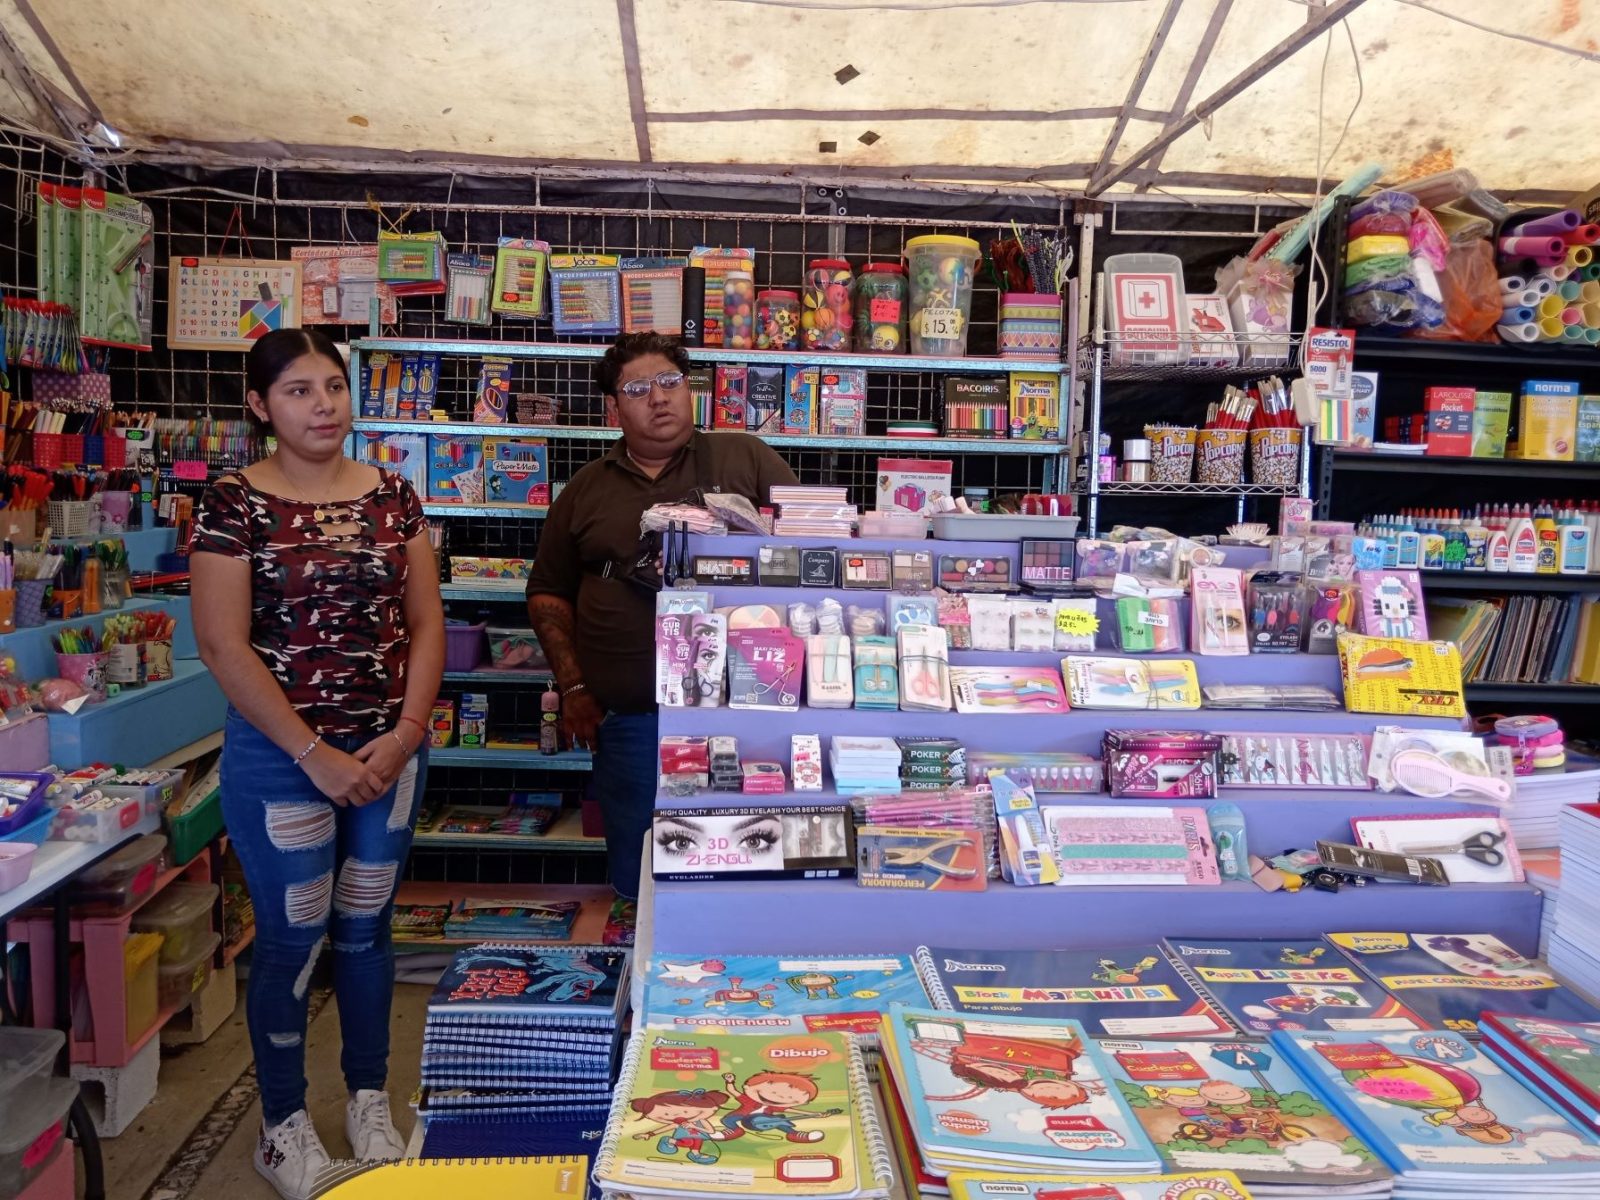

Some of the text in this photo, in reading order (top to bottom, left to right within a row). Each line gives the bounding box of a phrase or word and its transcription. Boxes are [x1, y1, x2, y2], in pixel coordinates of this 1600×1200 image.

[1312, 337, 1349, 348] RESISTOL
[956, 384, 999, 393] BACOIRIS
[1019, 382, 1051, 396] Norma
[1535, 383, 1572, 393] norma
[1433, 391, 1472, 400] LAROUSSE
[1440, 403, 1464, 412] Pocket
[485, 445, 495, 453] 48
[1204, 439, 1244, 462] POPCORN
[495, 461, 538, 472] Paper Mate
[1024, 566, 1071, 580] MATTE
[753, 650, 786, 663] LIZ
[910, 751, 941, 759] POKER
[911, 765, 942, 773] POKER
[909, 782, 940, 790] POKER
[678, 808, 707, 816] QUALITY
[740, 807, 749, 815] 3D
[749, 807, 781, 815] EYELASH
[781, 806, 801, 814] YOUR
[820, 805, 847, 813] CHOICE
[707, 837, 730, 850] 3D
[862, 878, 926, 888] PERFORADORA
[1182, 946, 1231, 956] Norma
[948, 959, 1005, 972] Norma
[1205, 969, 1351, 981] Papel Lustre
[1396, 976, 1544, 989] PAPEL CONSTRUCCIÓN
[964, 988, 1164, 1001] Block Marquilla
[964, 1003, 1023, 1012] Para dibujo
[1443, 1019, 1478, 1031] 50
[654, 1036, 696, 1047] Norma
[770, 1048, 829, 1060] Dibujo
[1433, 1042, 1463, 1059] A
[1236, 1051, 1256, 1066] A
[937, 1114, 989, 1127] Alemán
[940, 1121, 990, 1134] Cuadro
[1059, 1136, 1104, 1144] primer
[985, 1183, 1026, 1192] norma
